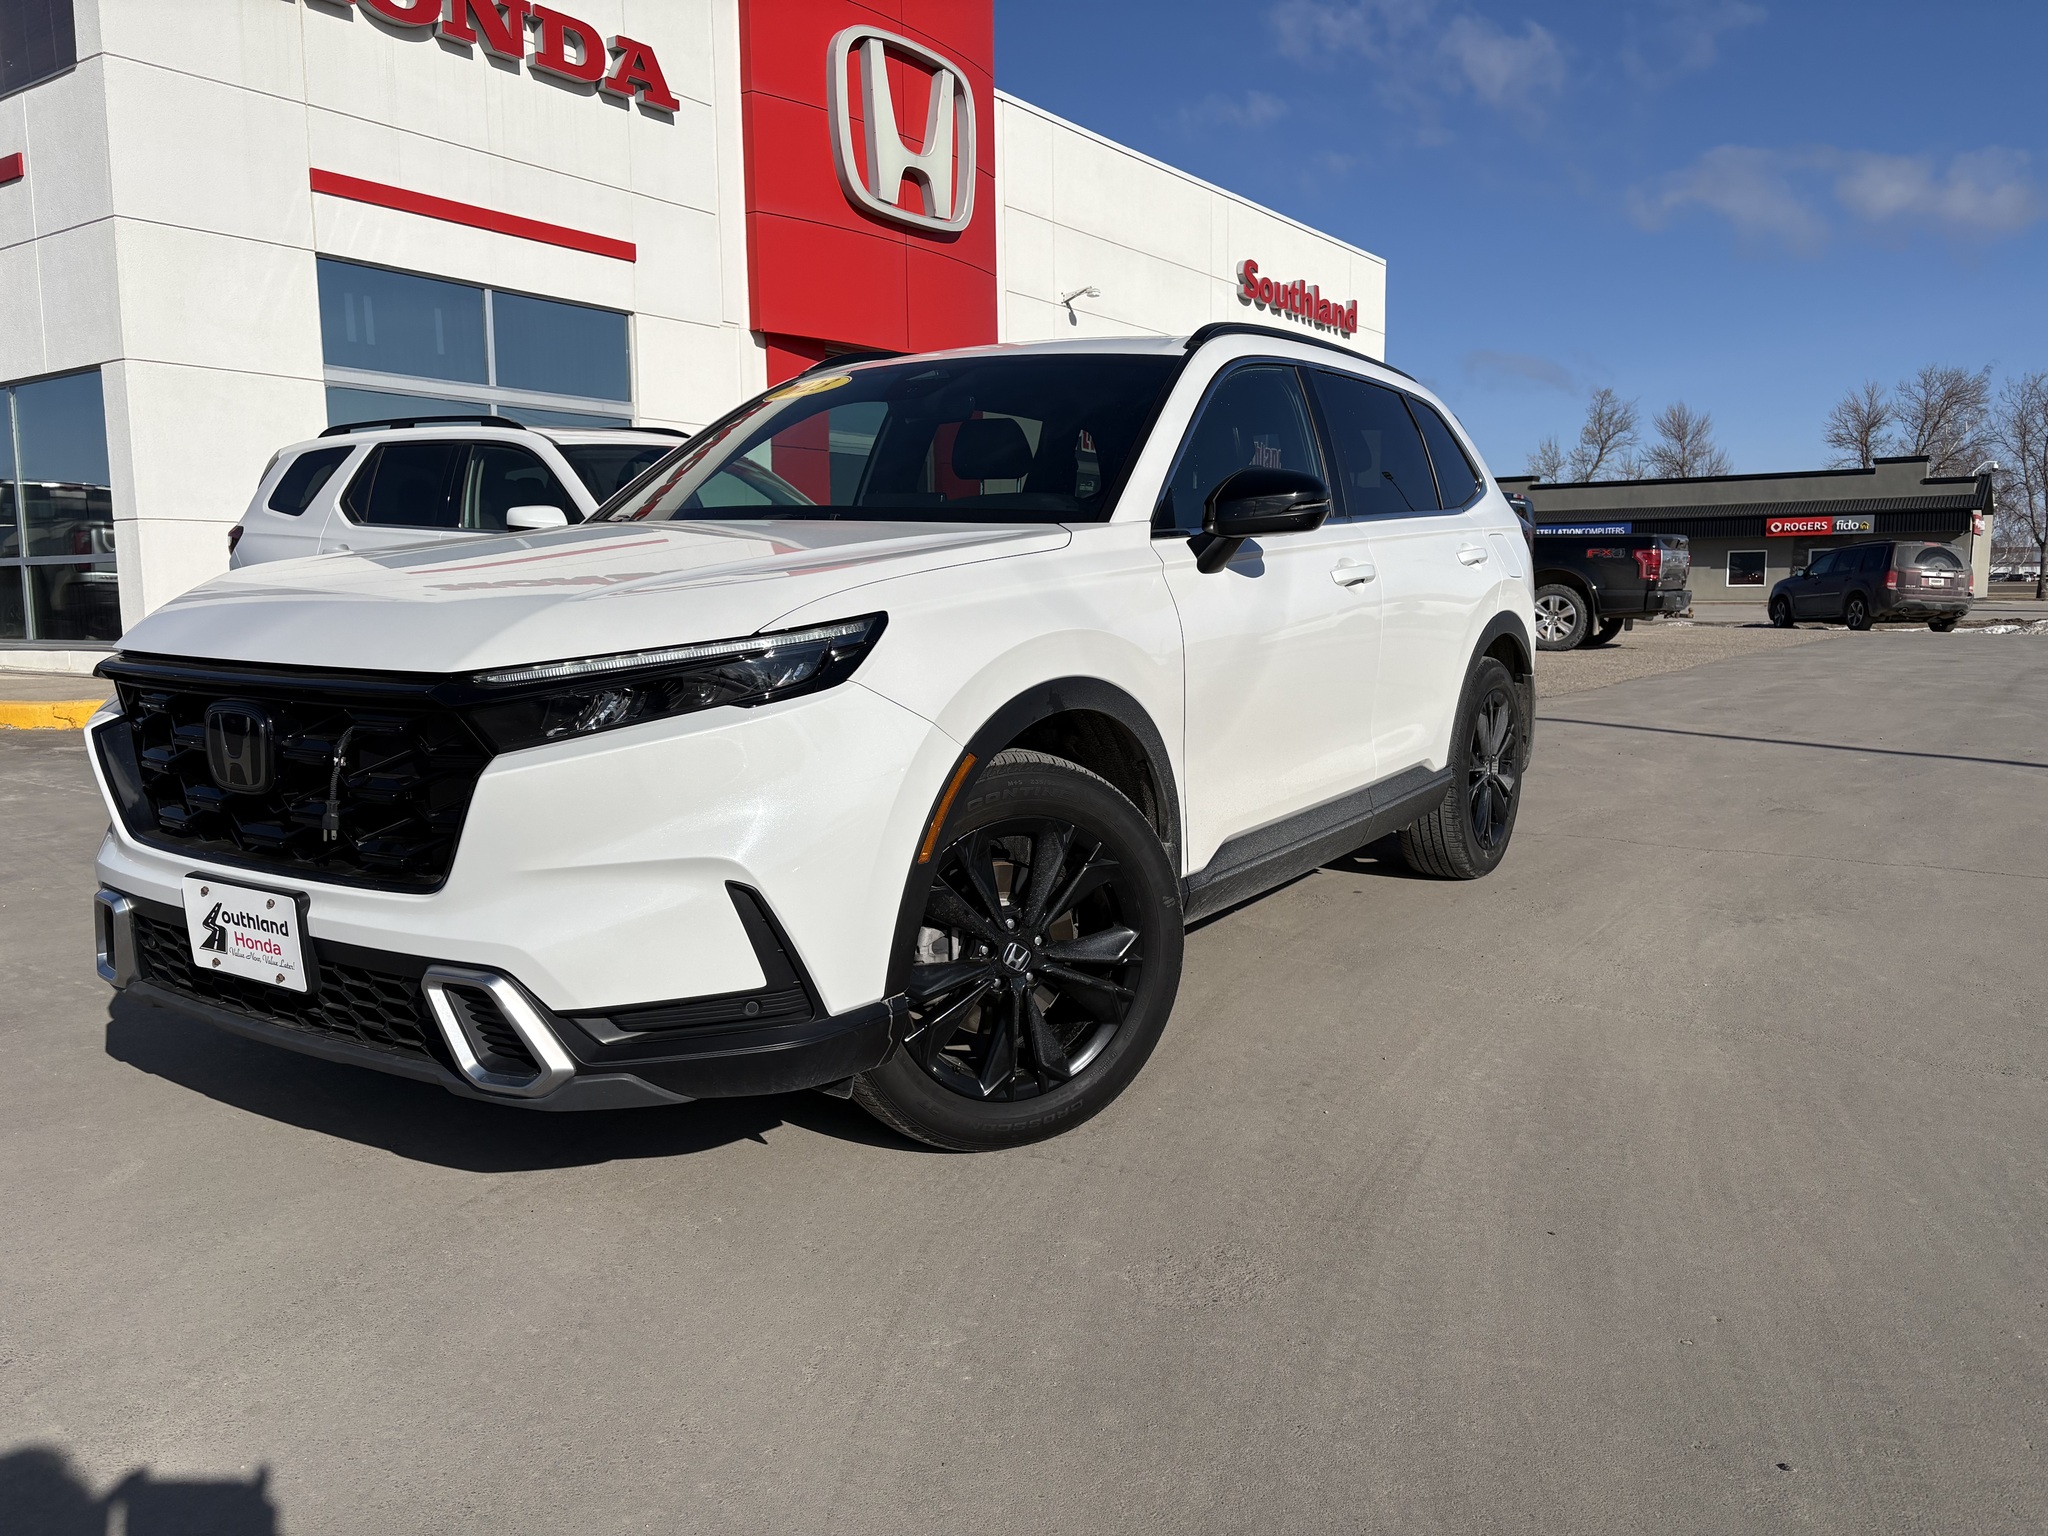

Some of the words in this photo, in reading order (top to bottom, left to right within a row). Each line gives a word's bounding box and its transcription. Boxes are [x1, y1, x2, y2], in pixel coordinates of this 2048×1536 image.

[328, 0, 680, 113] NDA
[1239, 259, 1357, 333] Southland
[1784, 521, 1828, 531] ROGERS
[1836, 519, 1859, 530] fido
[234, 931, 282, 956] Honda
[229, 947, 245, 959] Value
[262, 954, 279, 966] Value
